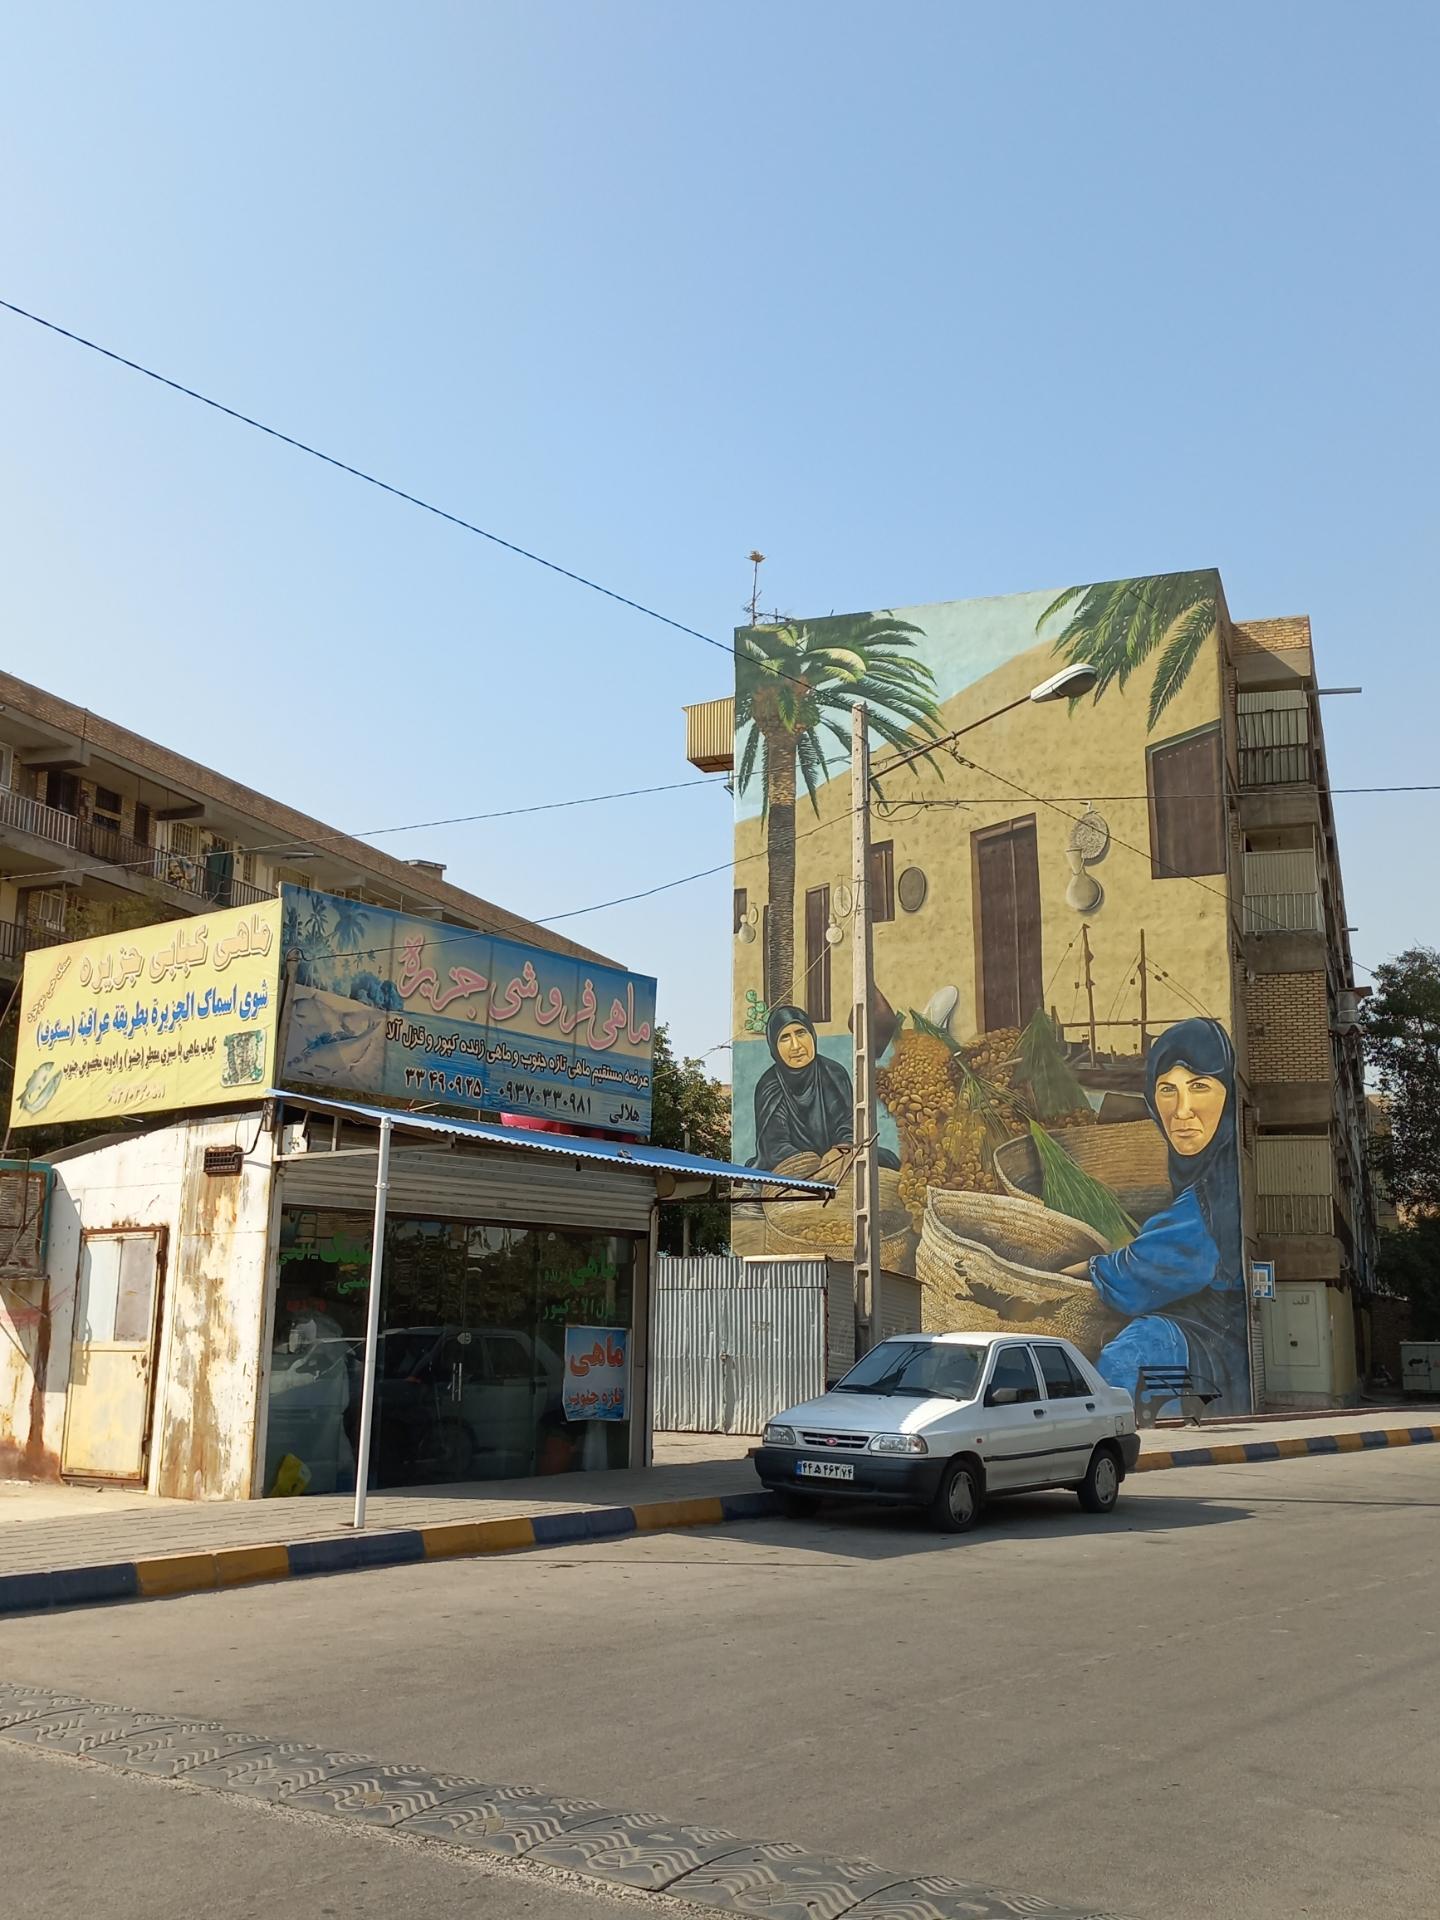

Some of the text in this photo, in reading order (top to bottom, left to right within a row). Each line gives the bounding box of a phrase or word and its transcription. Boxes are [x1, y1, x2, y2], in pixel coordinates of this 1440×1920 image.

[80, 914, 273, 994] ماهی کبابی جزیره
[488, 960, 597, 1033] فروشی
[587, 982, 650, 1050] ماهی
[386, 1017, 649, 1091] عرضه مستقیم ماهی تازه جنوب و ماهی زنده کپور و قزل آلا
[609, 1103, 640, 1124] هلالی
[569, 1334, 625, 1377] ماهی
[568, 1387, 624, 1409] تازه جنوب
